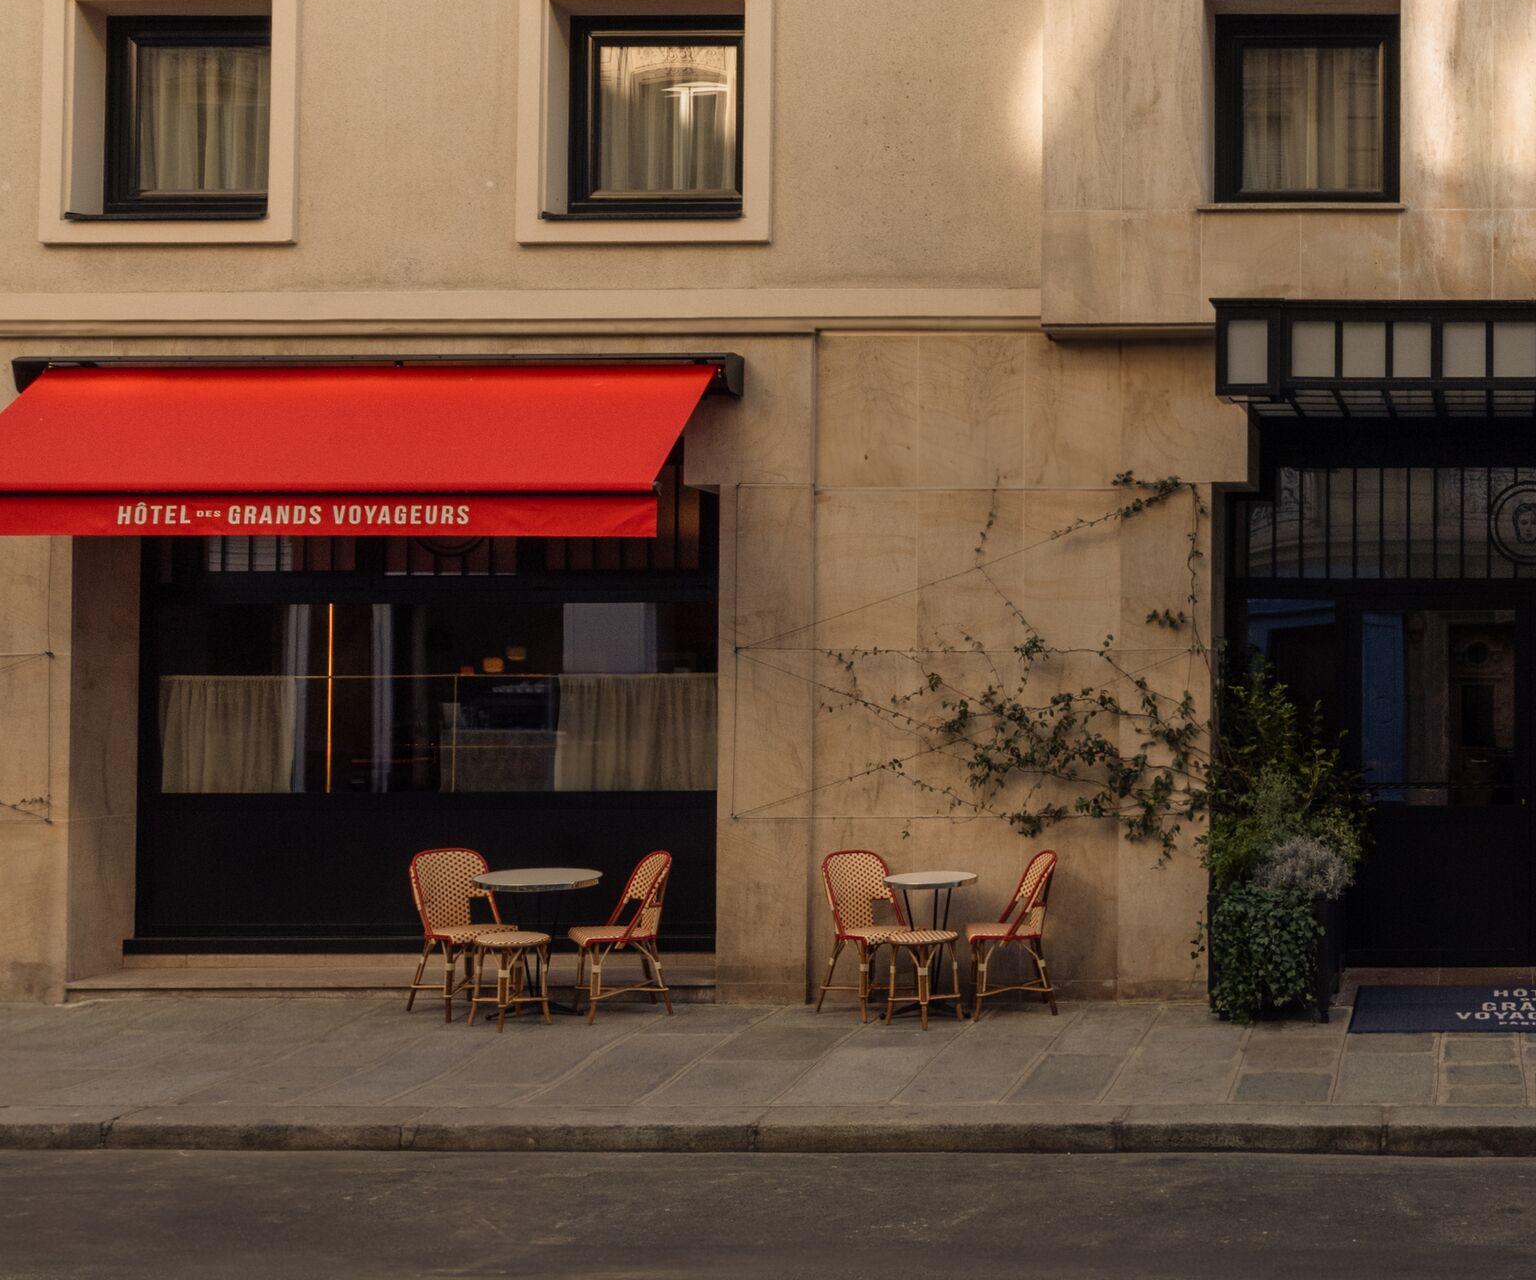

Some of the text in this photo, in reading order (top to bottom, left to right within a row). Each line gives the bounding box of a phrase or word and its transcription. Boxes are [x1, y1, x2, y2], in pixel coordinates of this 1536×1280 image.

[116, 501, 470, 525] HÔTEL DES GRANDS VOYAGEURS
